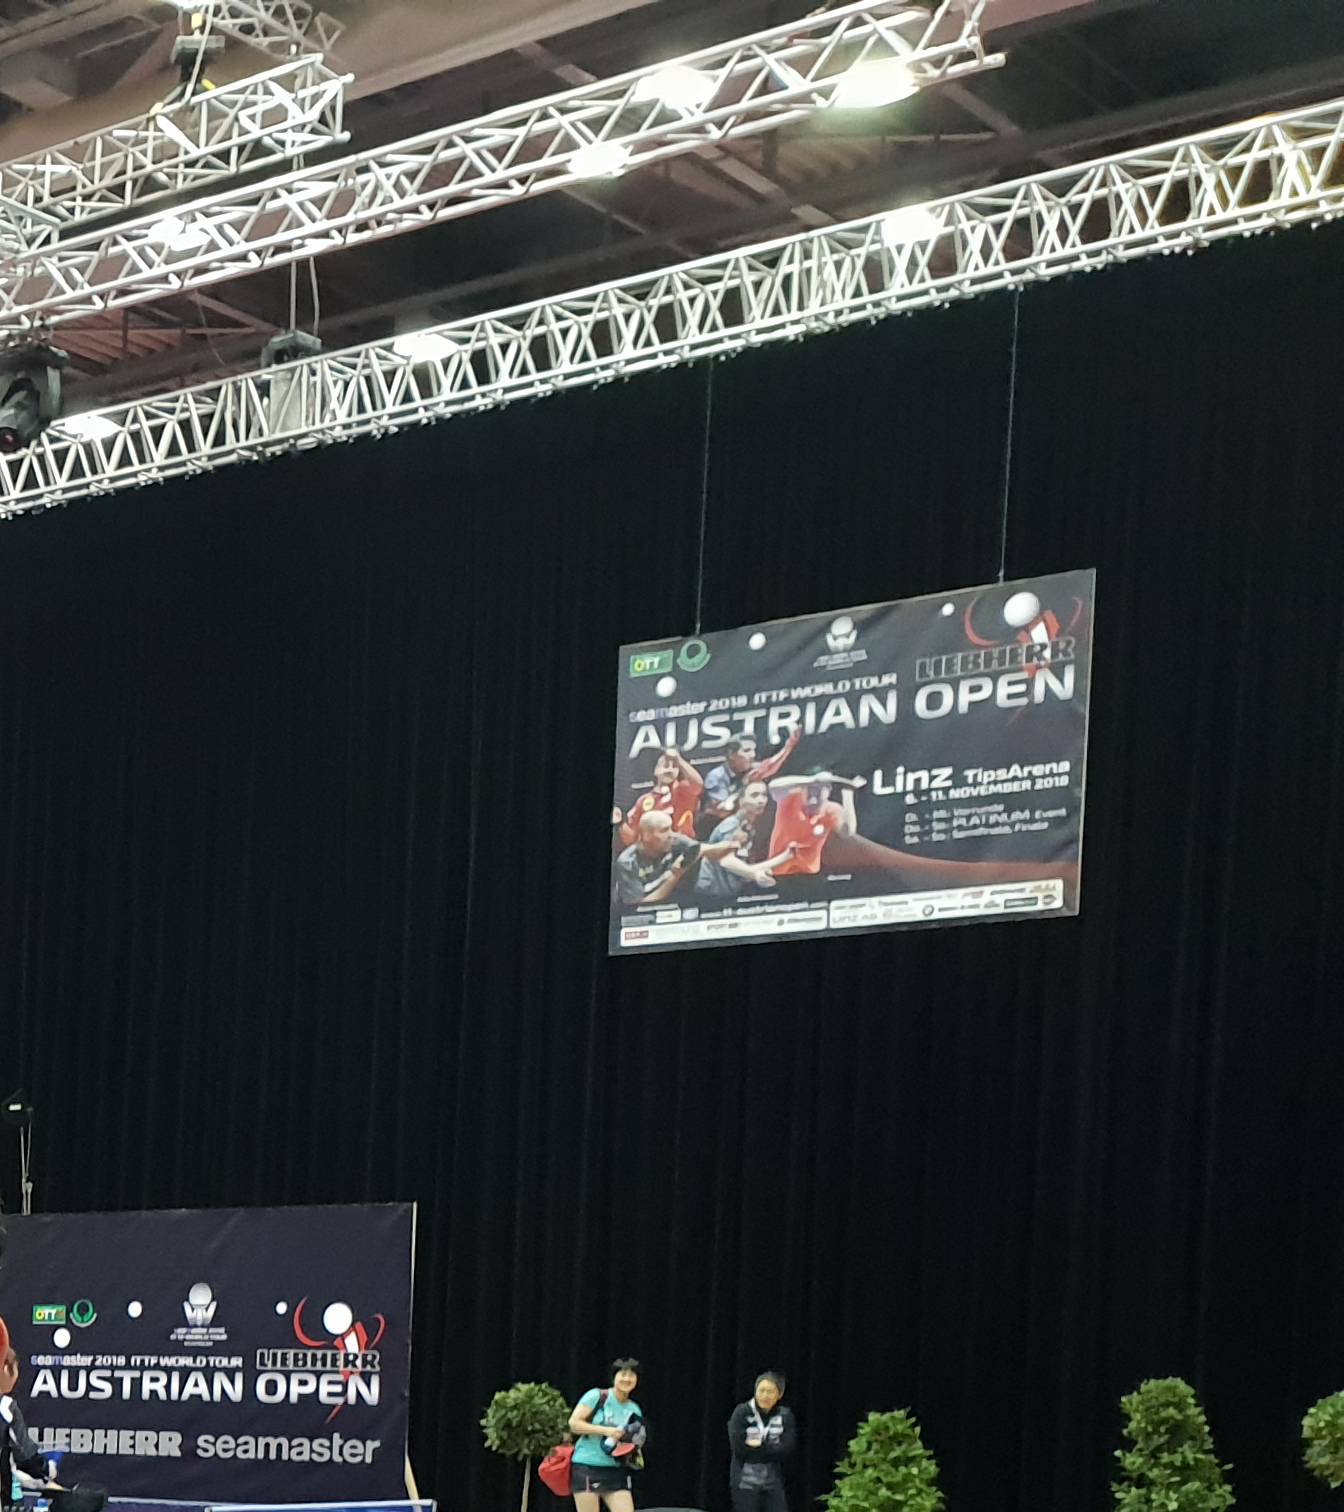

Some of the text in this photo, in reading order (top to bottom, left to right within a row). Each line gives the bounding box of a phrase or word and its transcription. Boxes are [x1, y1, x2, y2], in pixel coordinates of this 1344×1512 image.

[916, 636, 1075, 682] LIEBHERR
[709, 694, 748, 712] 2018
[791, 679, 851, 700] WORLD
[852, 672, 898, 691] TOUR
[629, 664, 1075, 759] AUSTRIAN OPEN
[872, 760, 1071, 796] Linz TipsArena
[949, 779, 1031, 799] NOVEMBER
[1033, 774, 1070, 790] 2018
[30, 1353, 243, 1369] seamaster 2018 ITTF WORLD TOUR
[256, 1349, 381, 1372] LIEBHERR
[30, 1368, 380, 1406] AUSTRIAN OPEN
[28, 1427, 381, 1464] LIEBHERR seamaster
